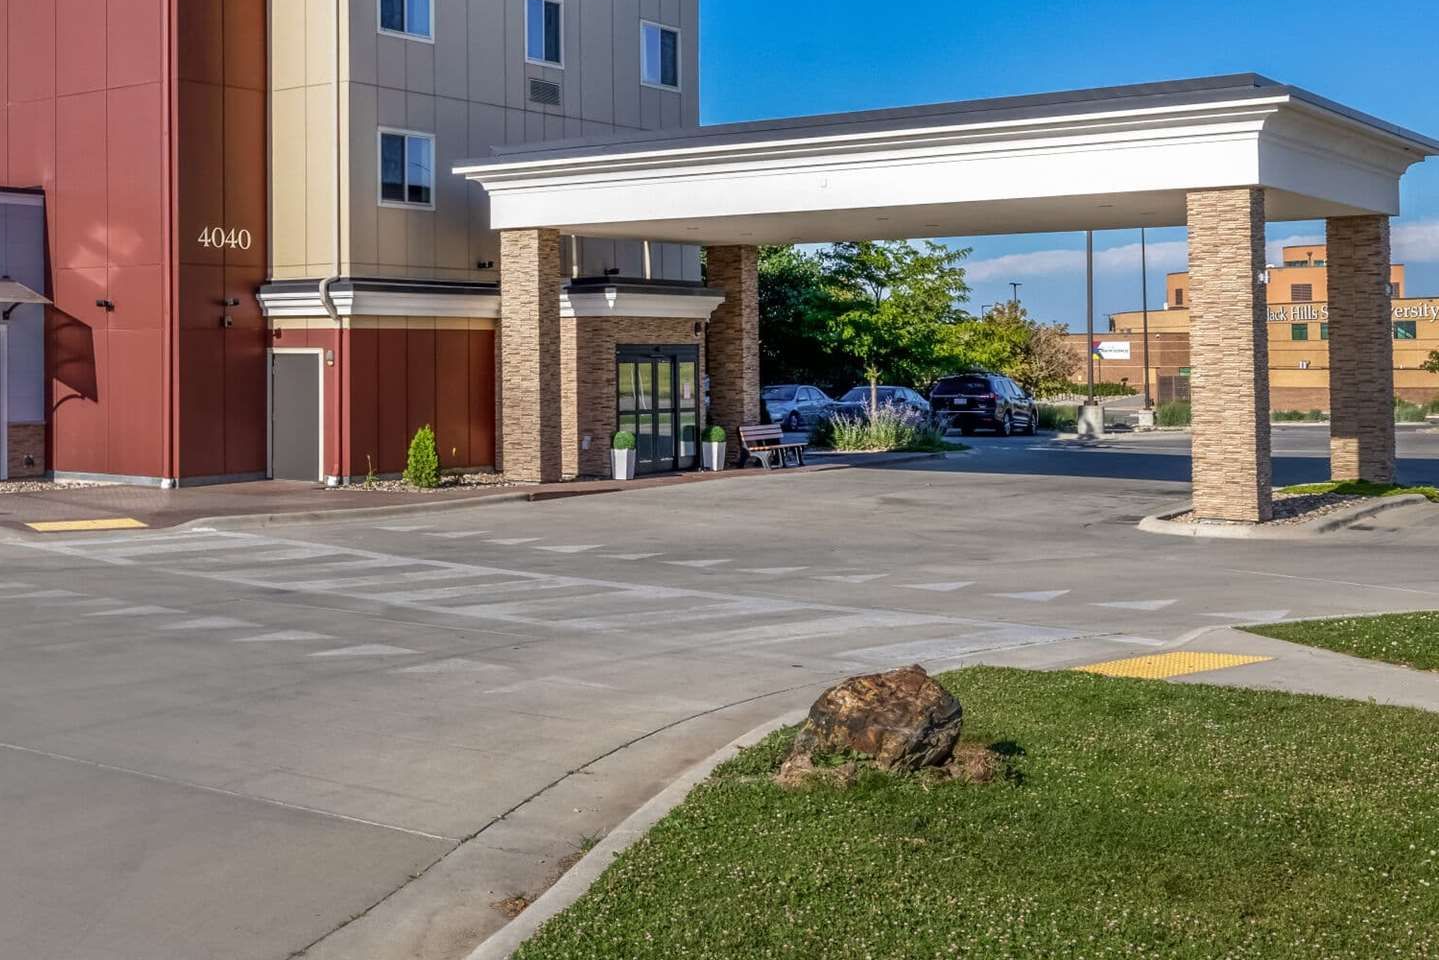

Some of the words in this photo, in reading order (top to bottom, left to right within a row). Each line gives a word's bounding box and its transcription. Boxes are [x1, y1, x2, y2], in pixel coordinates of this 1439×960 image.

[197, 226, 252, 250] 4040
[1266, 305, 1288, 321] lack
[1290, 304, 1318, 320] Hills
[1391, 302, 1439, 322] ersity
